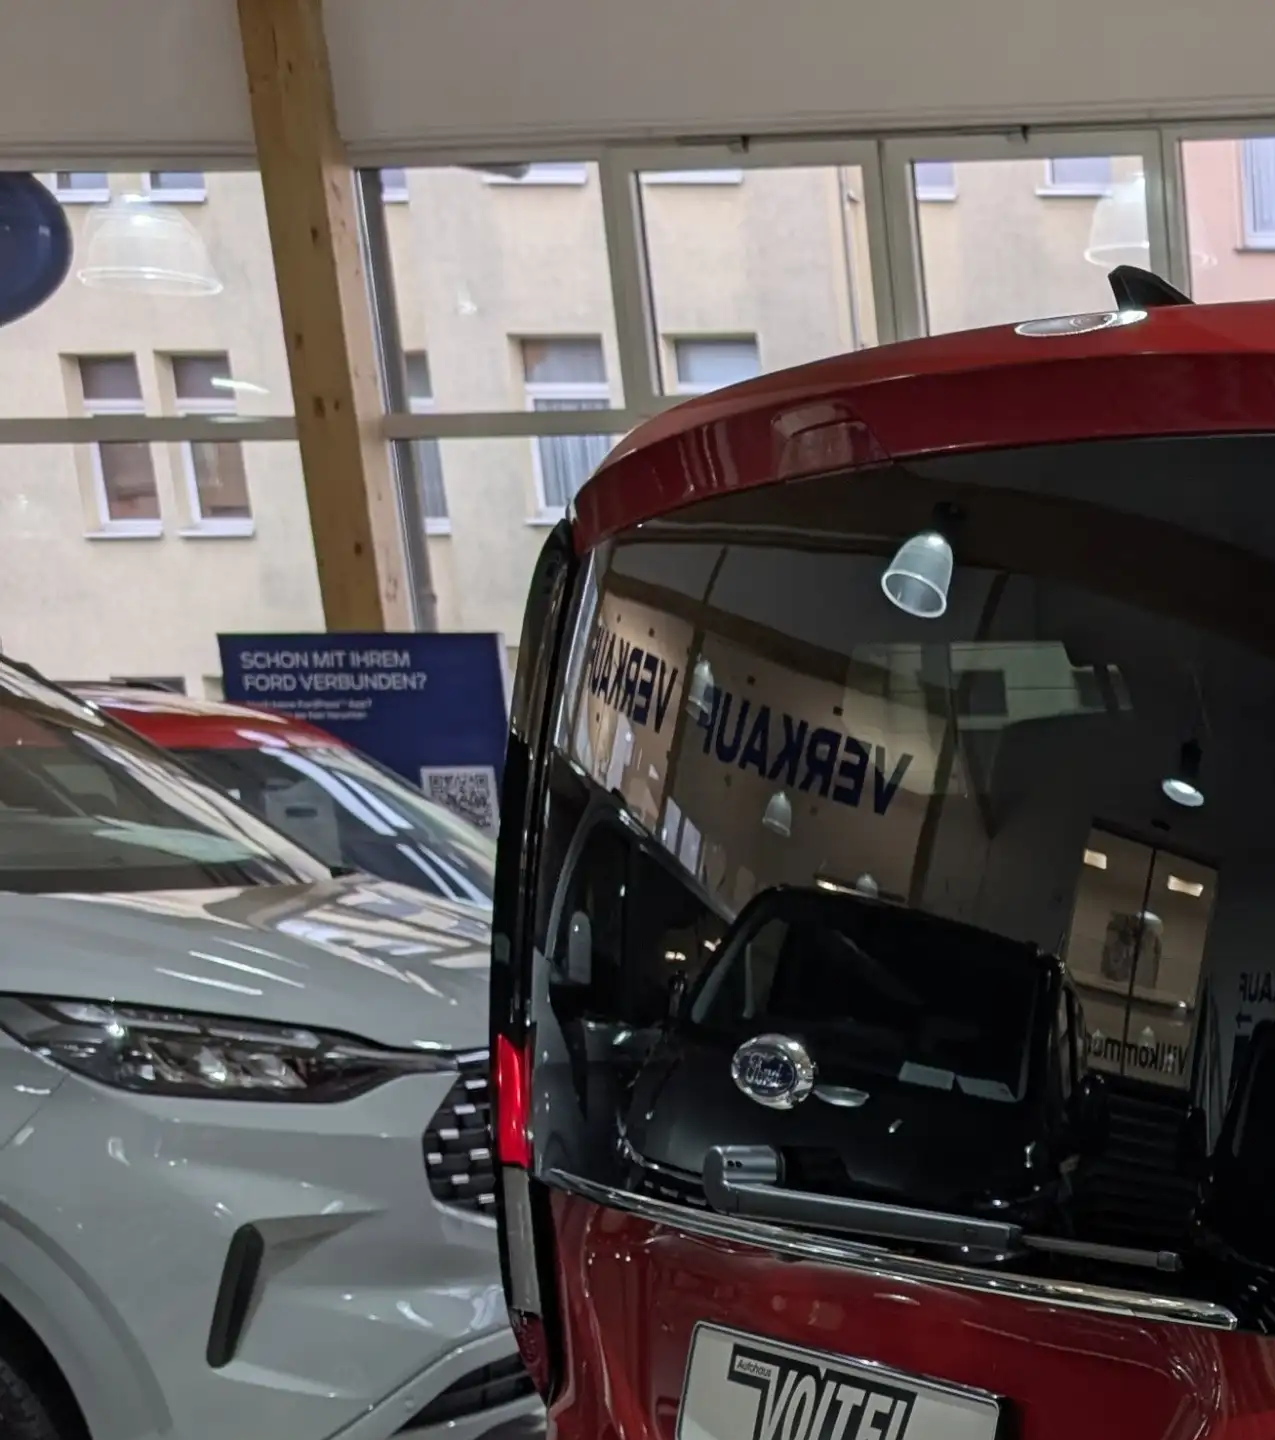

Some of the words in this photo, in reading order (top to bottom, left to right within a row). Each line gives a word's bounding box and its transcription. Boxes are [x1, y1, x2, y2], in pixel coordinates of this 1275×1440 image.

[240, 651, 309, 669] SCHON
[313, 651, 346, 669] MIT
[350, 651, 411, 668] IHREM
[243, 674, 297, 691] FORD
[300, 672, 427, 691] VERBUNDEN?
[737, 1359, 772, 1377] Autohaus
